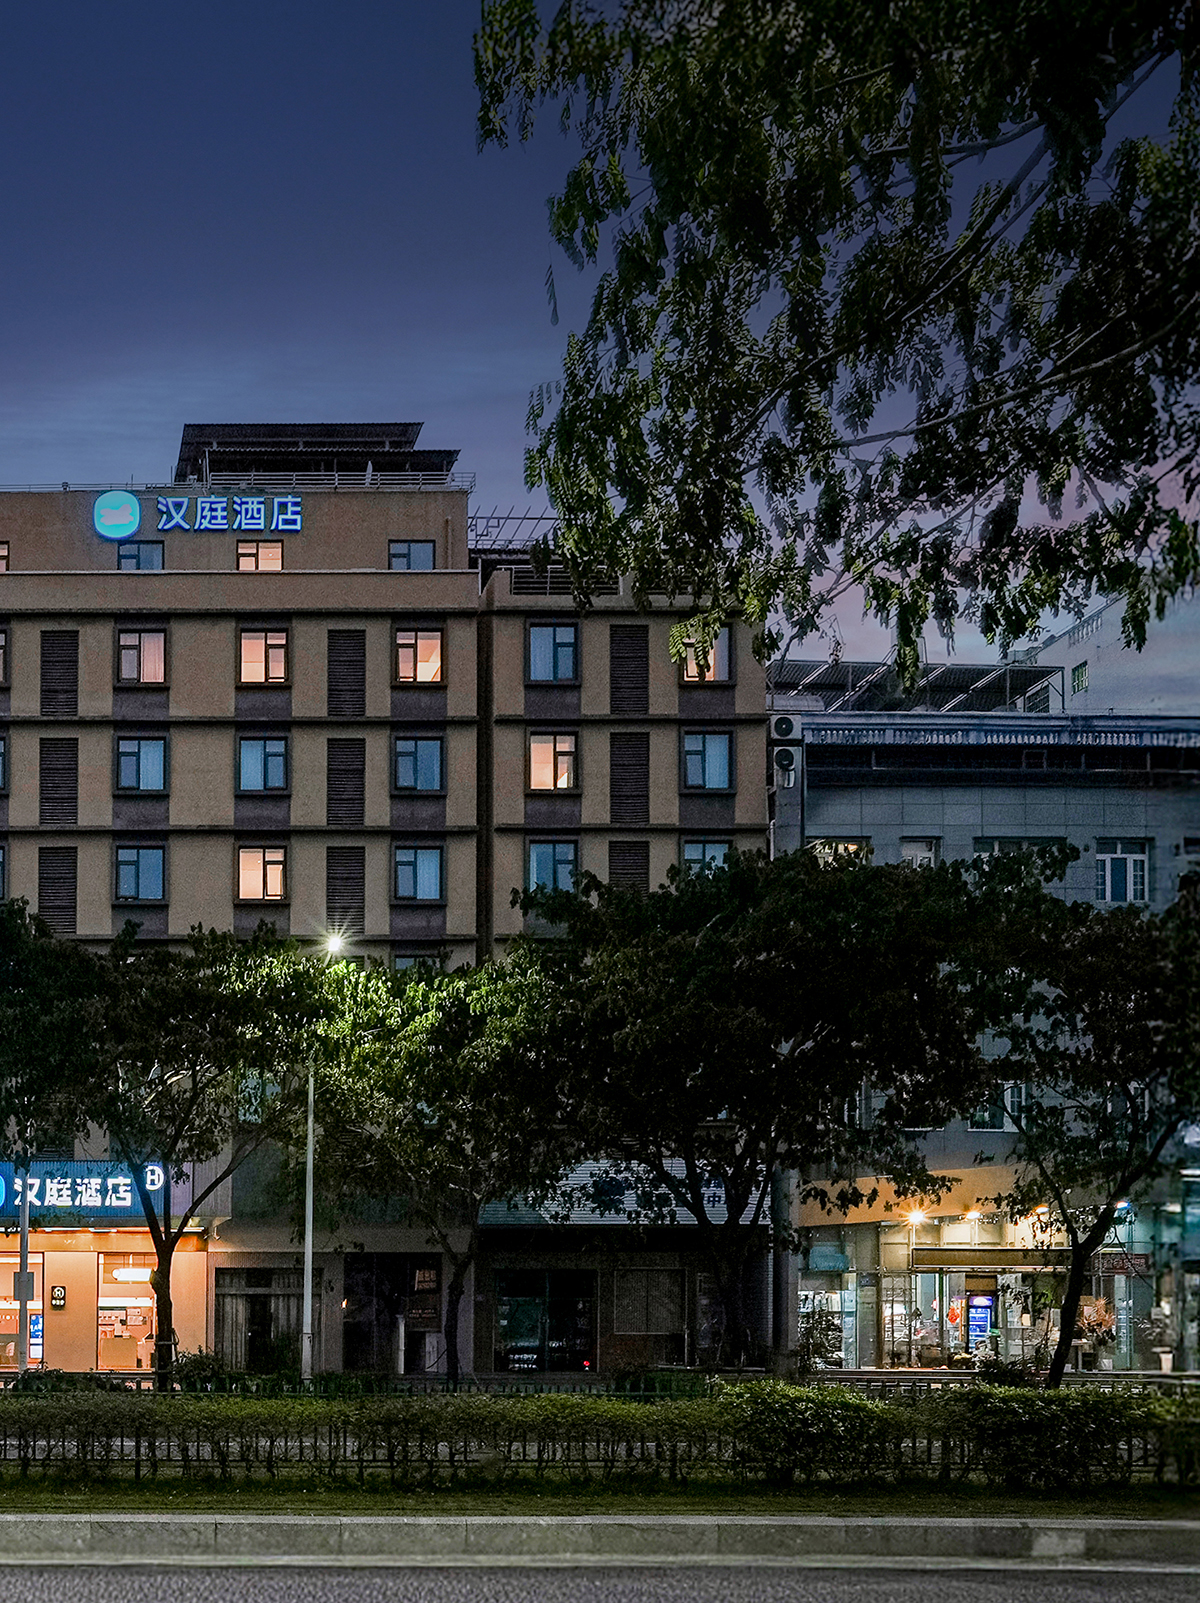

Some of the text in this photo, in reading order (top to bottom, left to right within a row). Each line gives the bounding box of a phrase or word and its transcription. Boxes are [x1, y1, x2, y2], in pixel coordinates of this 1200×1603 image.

[157, 494, 302, 530] 汉庭酒店
[14, 1176, 131, 1207] 汉庭酒店
